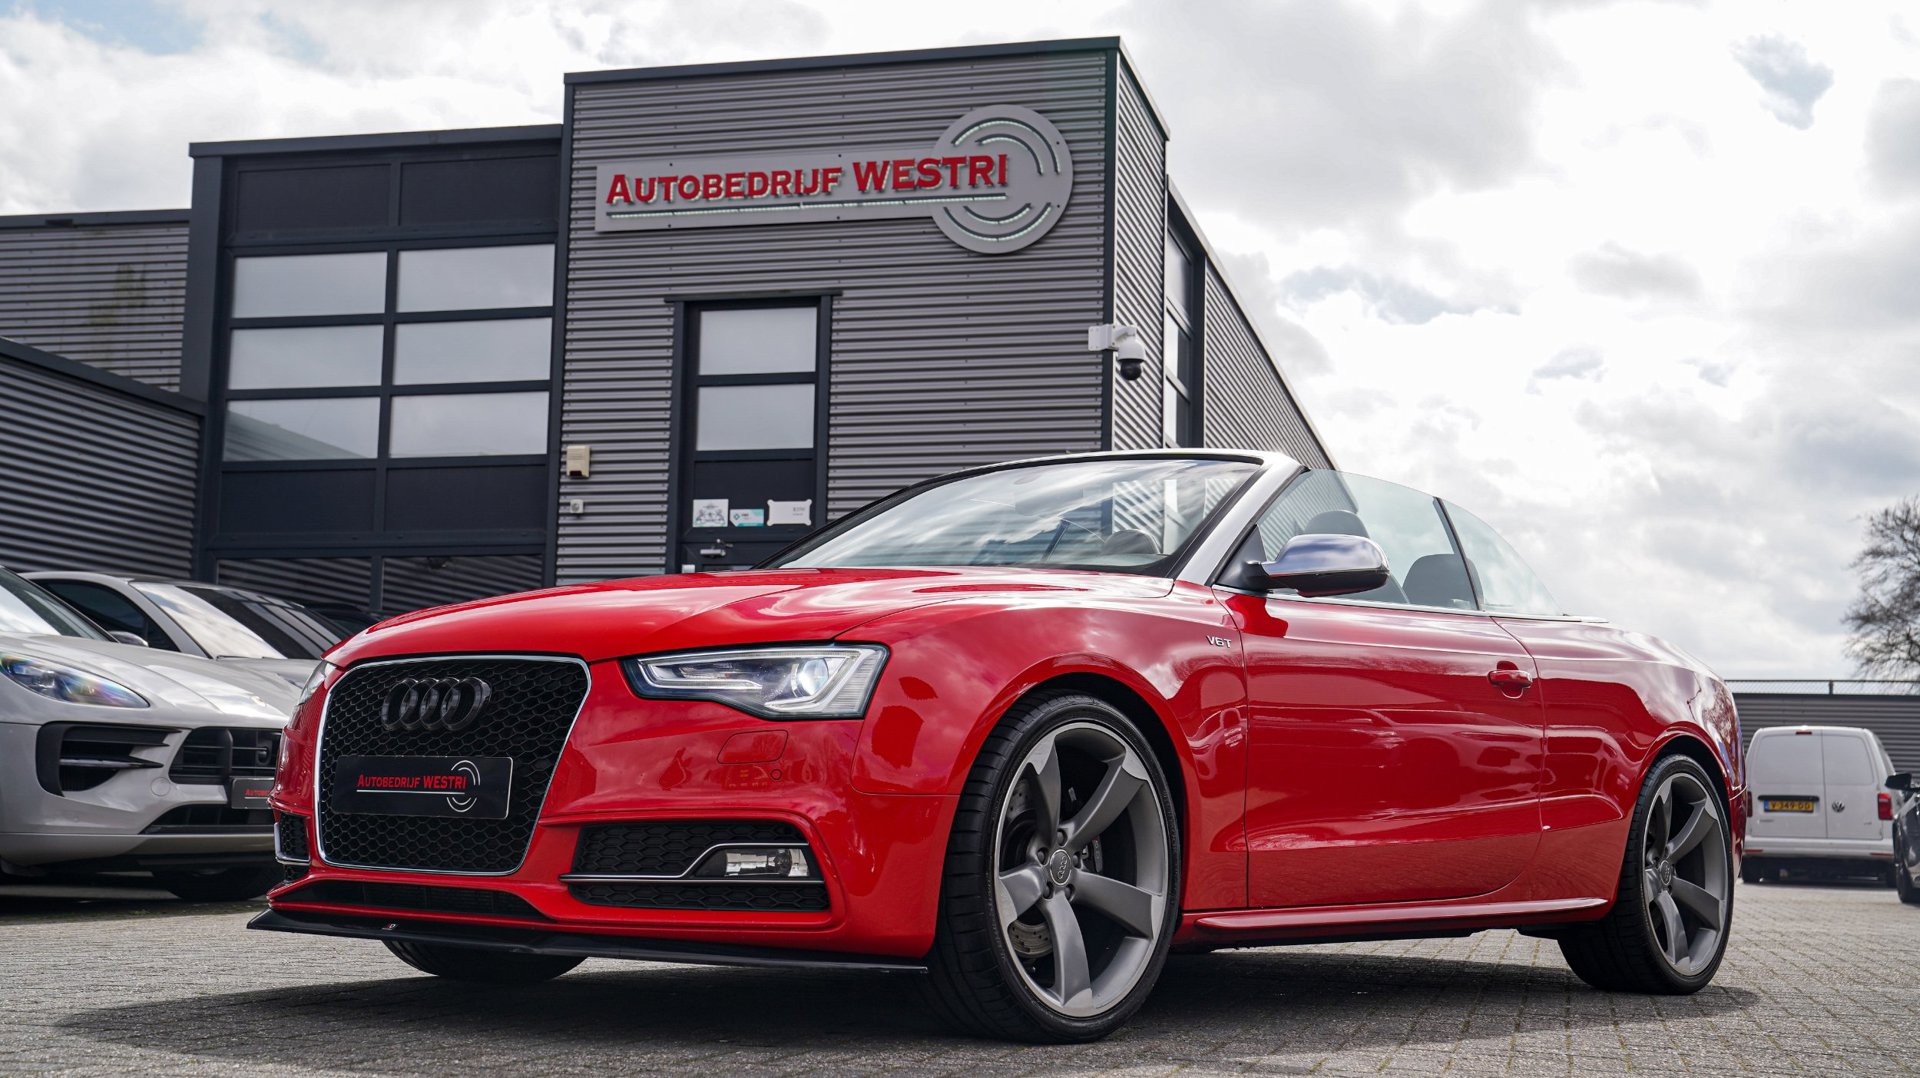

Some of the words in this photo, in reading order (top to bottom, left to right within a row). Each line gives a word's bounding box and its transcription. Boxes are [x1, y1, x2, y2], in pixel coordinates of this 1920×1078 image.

[607, 168, 842, 203] AUTOBEDRIJF
[852, 154, 1007, 191] WESTRI
[1205, 635, 1232, 648] V6T
[357, 774, 421, 788] AUTOBEDRIJF
[423, 775, 467, 789] WESTRI
